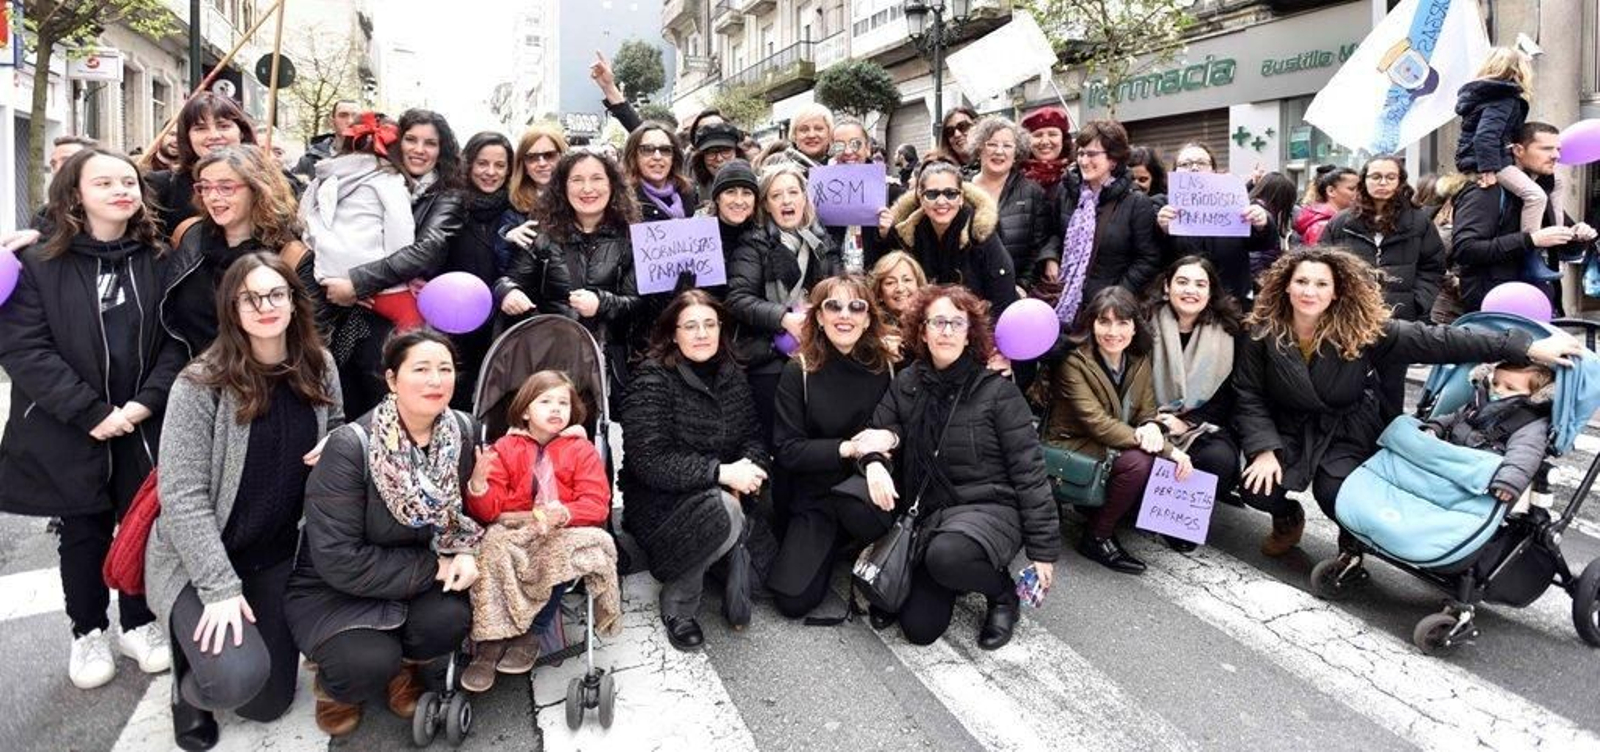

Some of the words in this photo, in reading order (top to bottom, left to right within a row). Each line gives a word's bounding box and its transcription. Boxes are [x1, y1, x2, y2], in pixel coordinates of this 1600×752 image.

[813, 178, 866, 208] #8M
[645, 224, 666, 243] AS
[647, 258, 713, 282] PARAMOS
